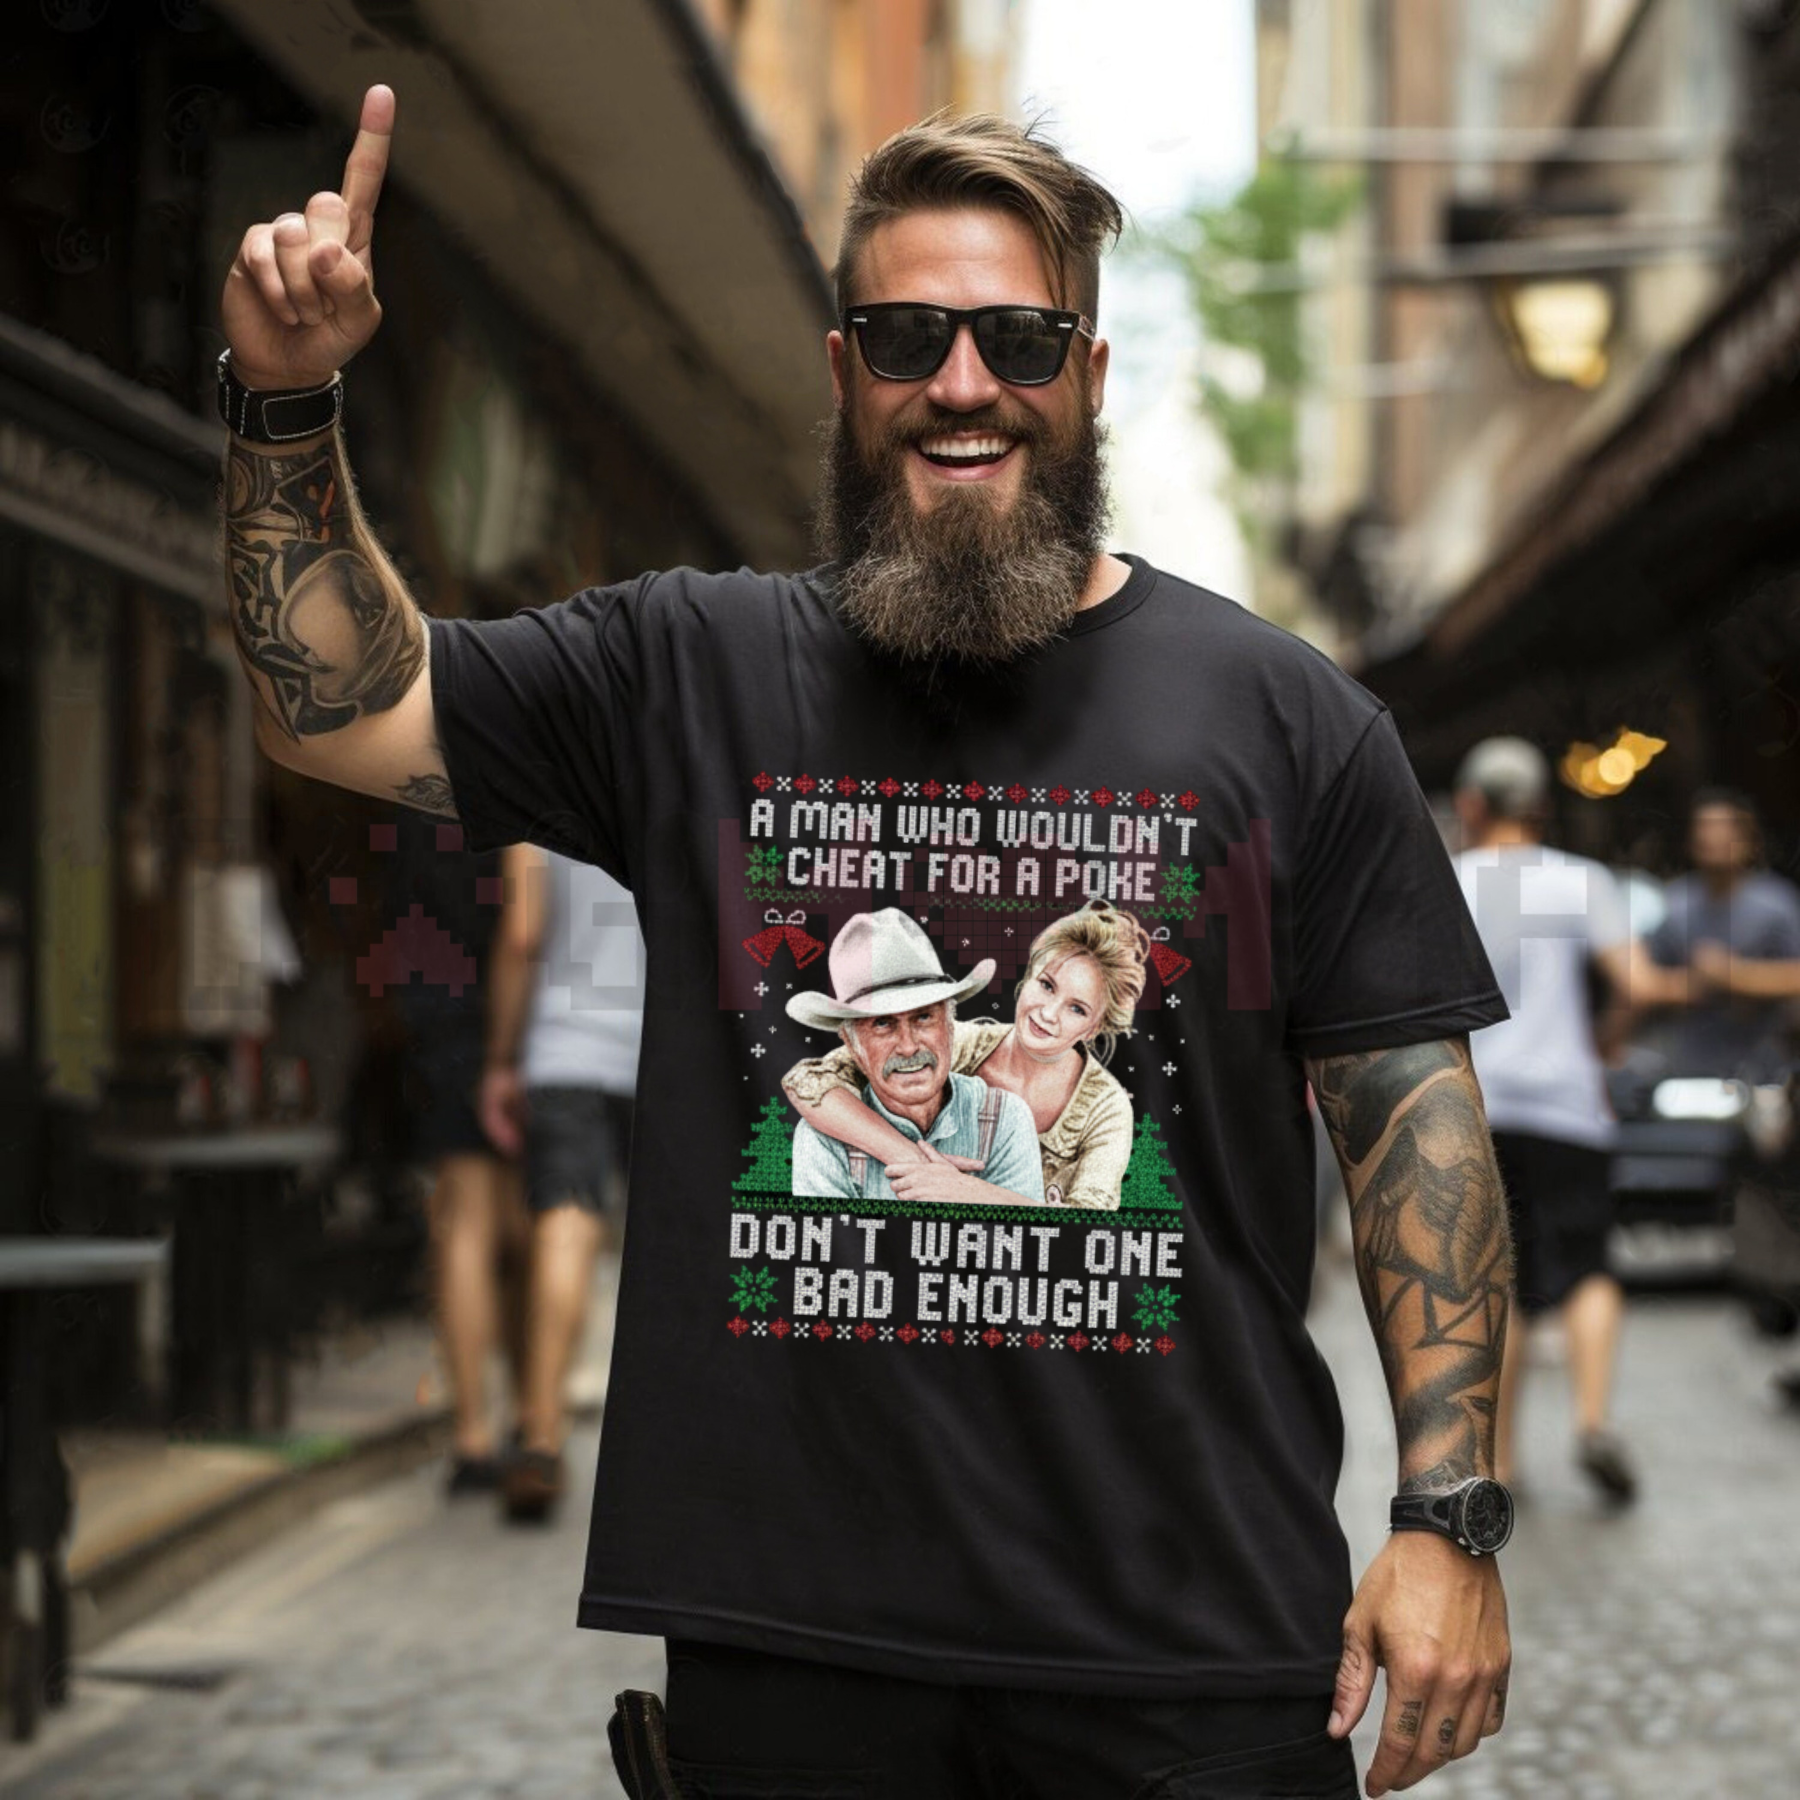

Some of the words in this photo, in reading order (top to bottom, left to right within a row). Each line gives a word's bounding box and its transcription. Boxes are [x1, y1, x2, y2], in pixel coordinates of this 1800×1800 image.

[749, 798, 776, 838] A
[789, 799, 882, 843] MAN
[897, 804, 981, 847] WHO
[996, 808, 1198, 857] WOULDN'T
[786, 845, 912, 891] CHEAT
[927, 851, 1001, 895] FOR
[1016, 856, 1040, 897] A
[1055, 858, 1156, 902] POKE
[729, 1212, 886, 1265] DON'T
[910, 1220, 1060, 1273] WANT
[1083, 1229, 1184, 1278] ONE
[792, 1266, 894, 1319] BAD
[917, 1271, 1119, 1330] ENOUGH
